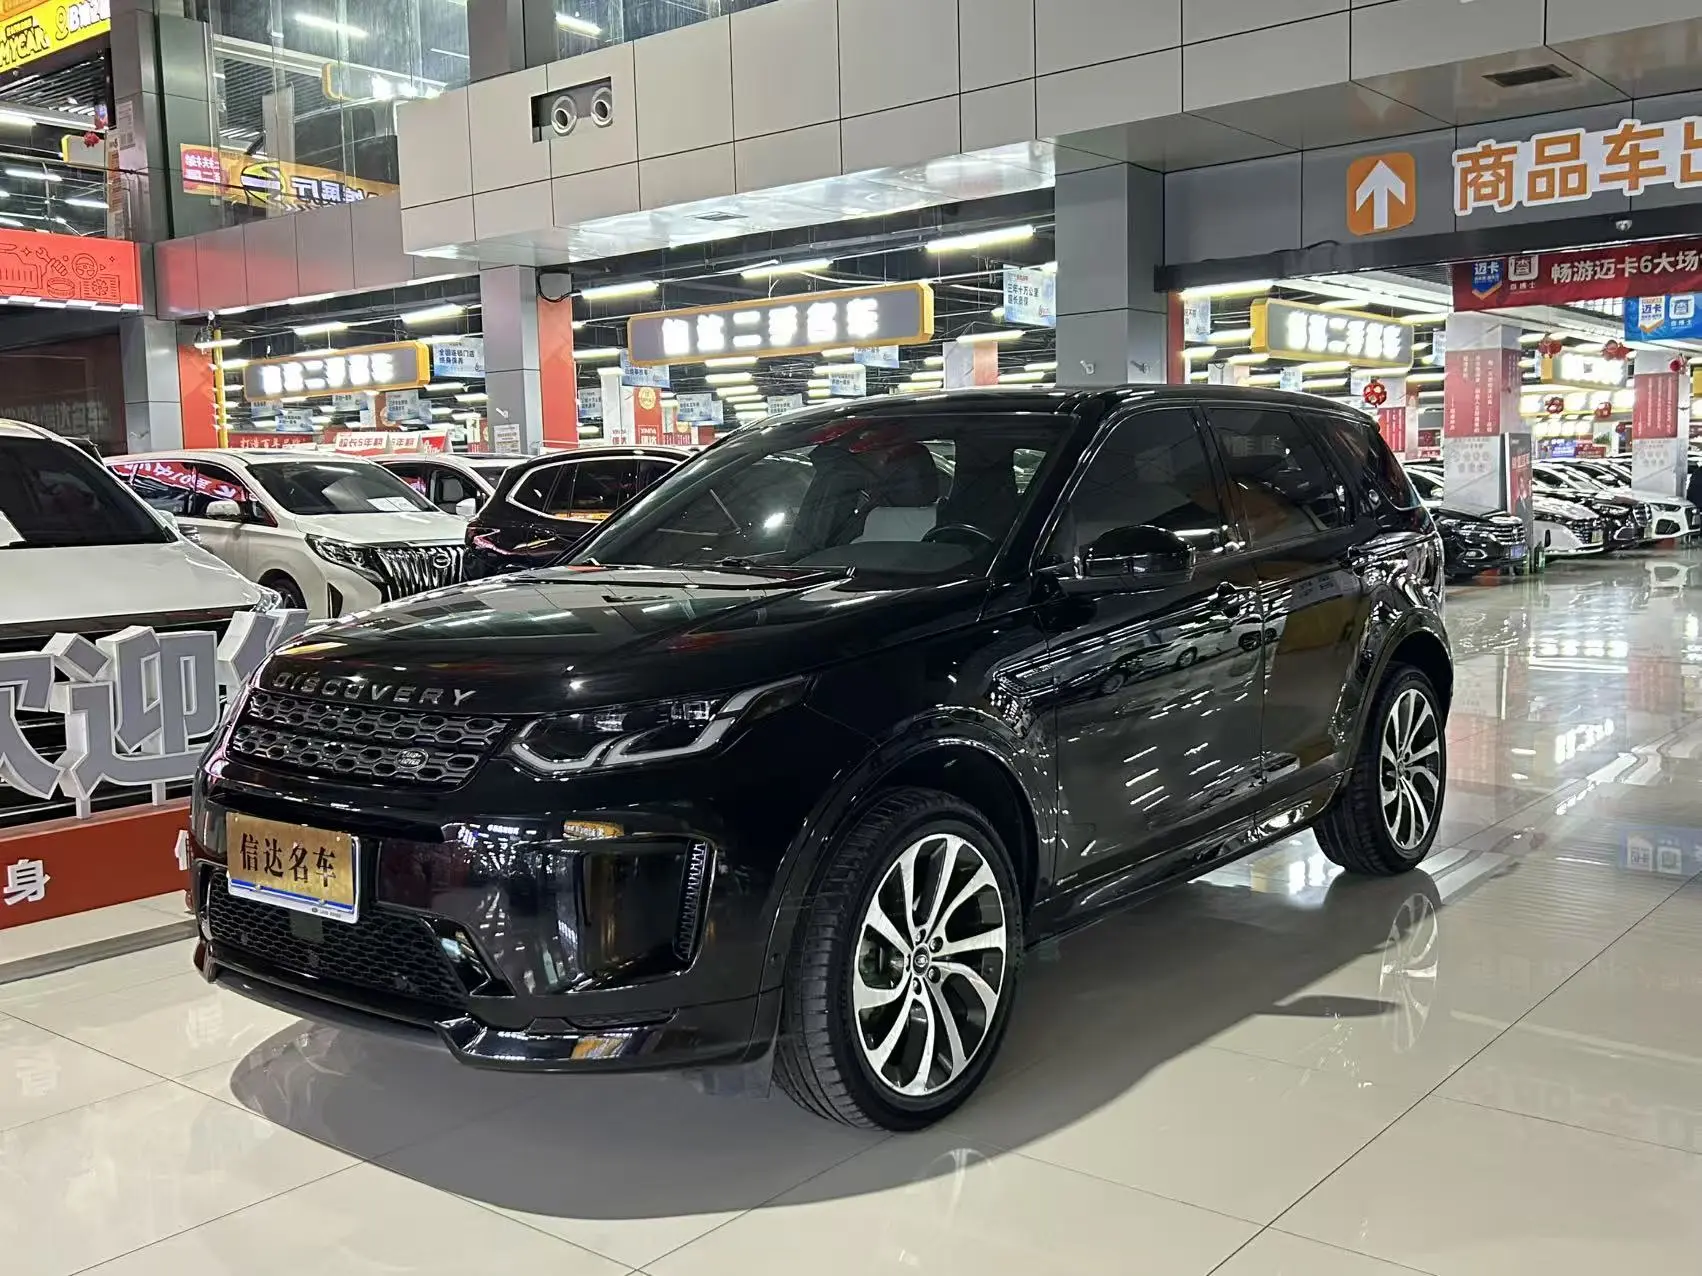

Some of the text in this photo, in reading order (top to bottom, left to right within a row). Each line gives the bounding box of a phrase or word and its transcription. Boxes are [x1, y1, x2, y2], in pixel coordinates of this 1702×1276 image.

[1474, 261, 1500, 275] 迈卡
[1551, 249, 1702, 284] 畅游迈卡6大场
[272, 671, 477, 708] DISCOVERY
[240, 832, 337, 888] 信达名车
[4, 858, 51, 906] 身
